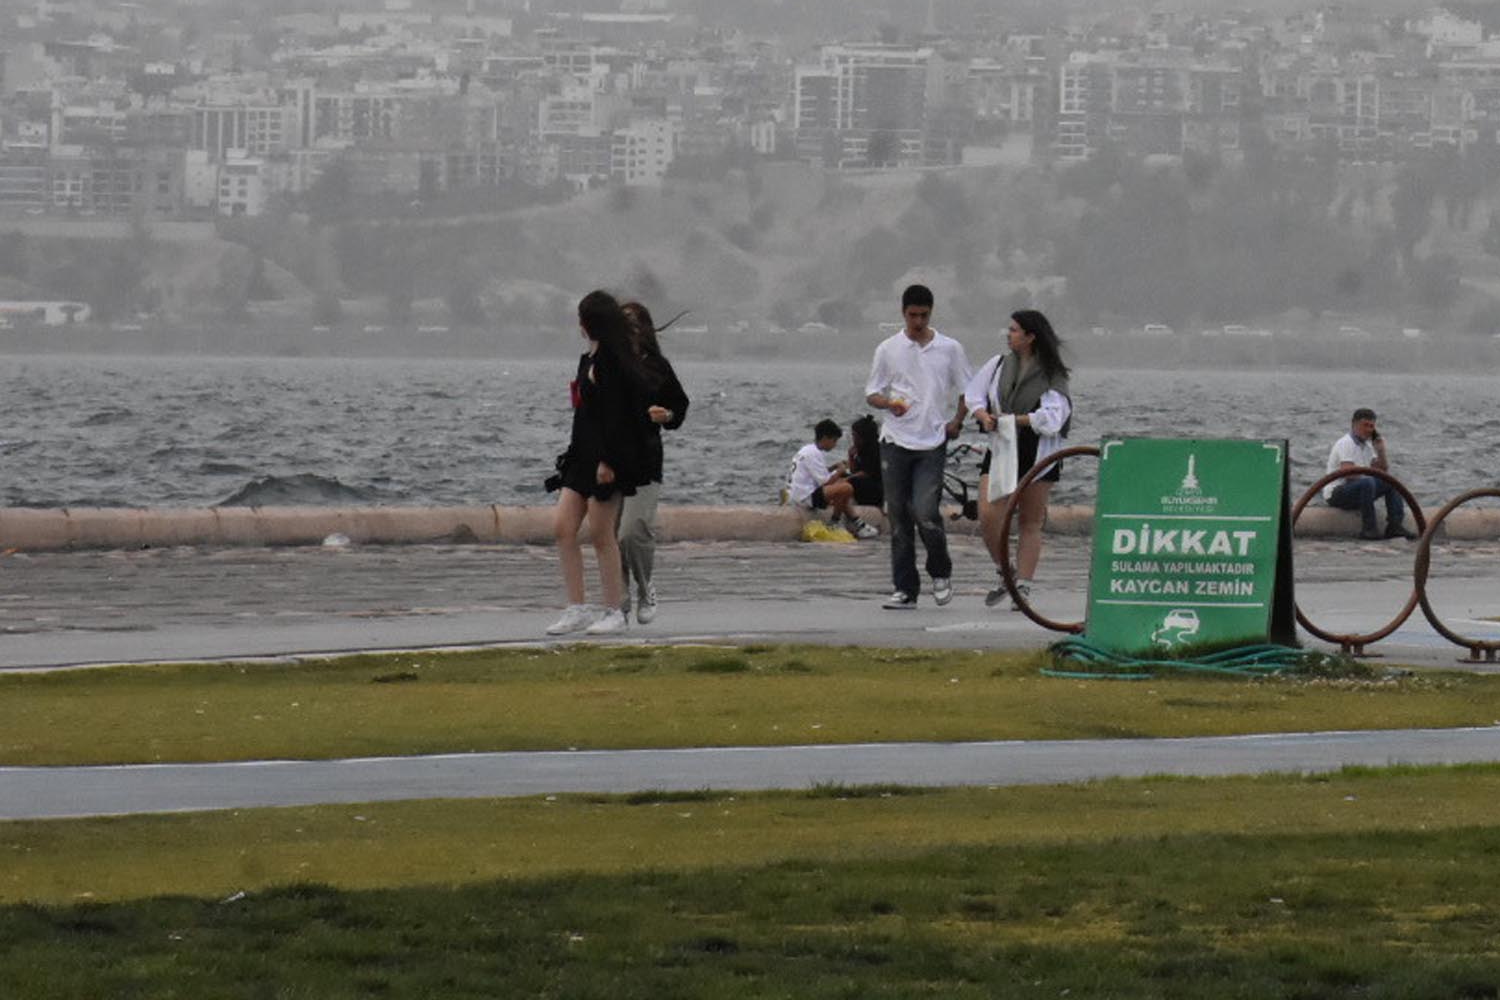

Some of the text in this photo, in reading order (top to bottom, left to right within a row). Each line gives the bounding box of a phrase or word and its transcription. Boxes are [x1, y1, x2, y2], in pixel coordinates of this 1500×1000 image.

[1112, 523, 1256, 556] DİKKAT
[1111, 560, 1255, 575] SULAMA YAPILMAKTADIR
[1195, 577, 1254, 595] ZEMİN
